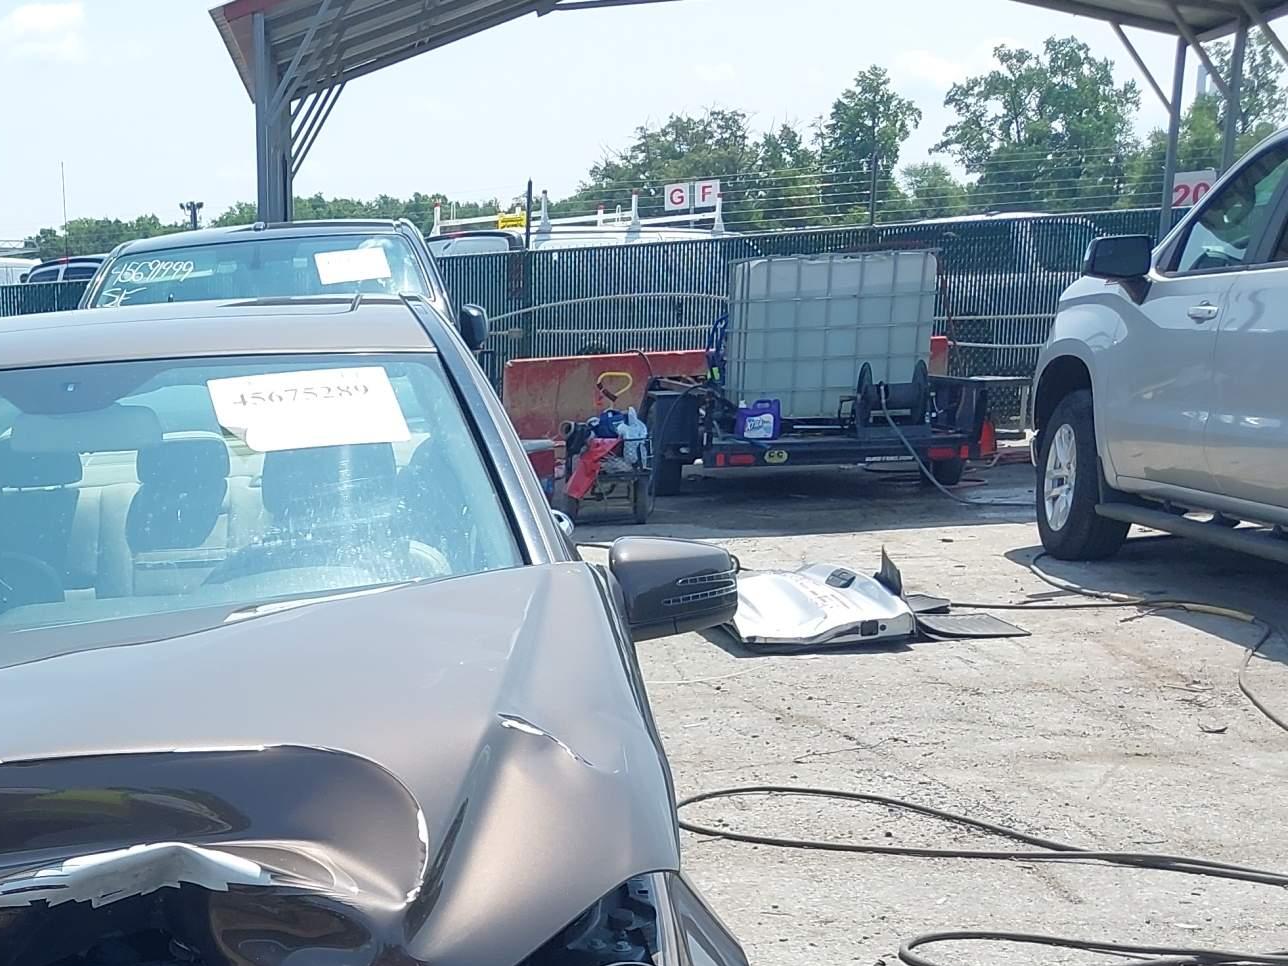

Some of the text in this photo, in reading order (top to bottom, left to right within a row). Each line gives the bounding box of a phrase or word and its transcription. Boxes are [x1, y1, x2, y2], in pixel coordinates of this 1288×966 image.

[670, 189, 685, 205] G
[702, 185, 712, 202] F
[1173, 183, 1210, 207] 20
[233, 385, 369, 406] 45675289
